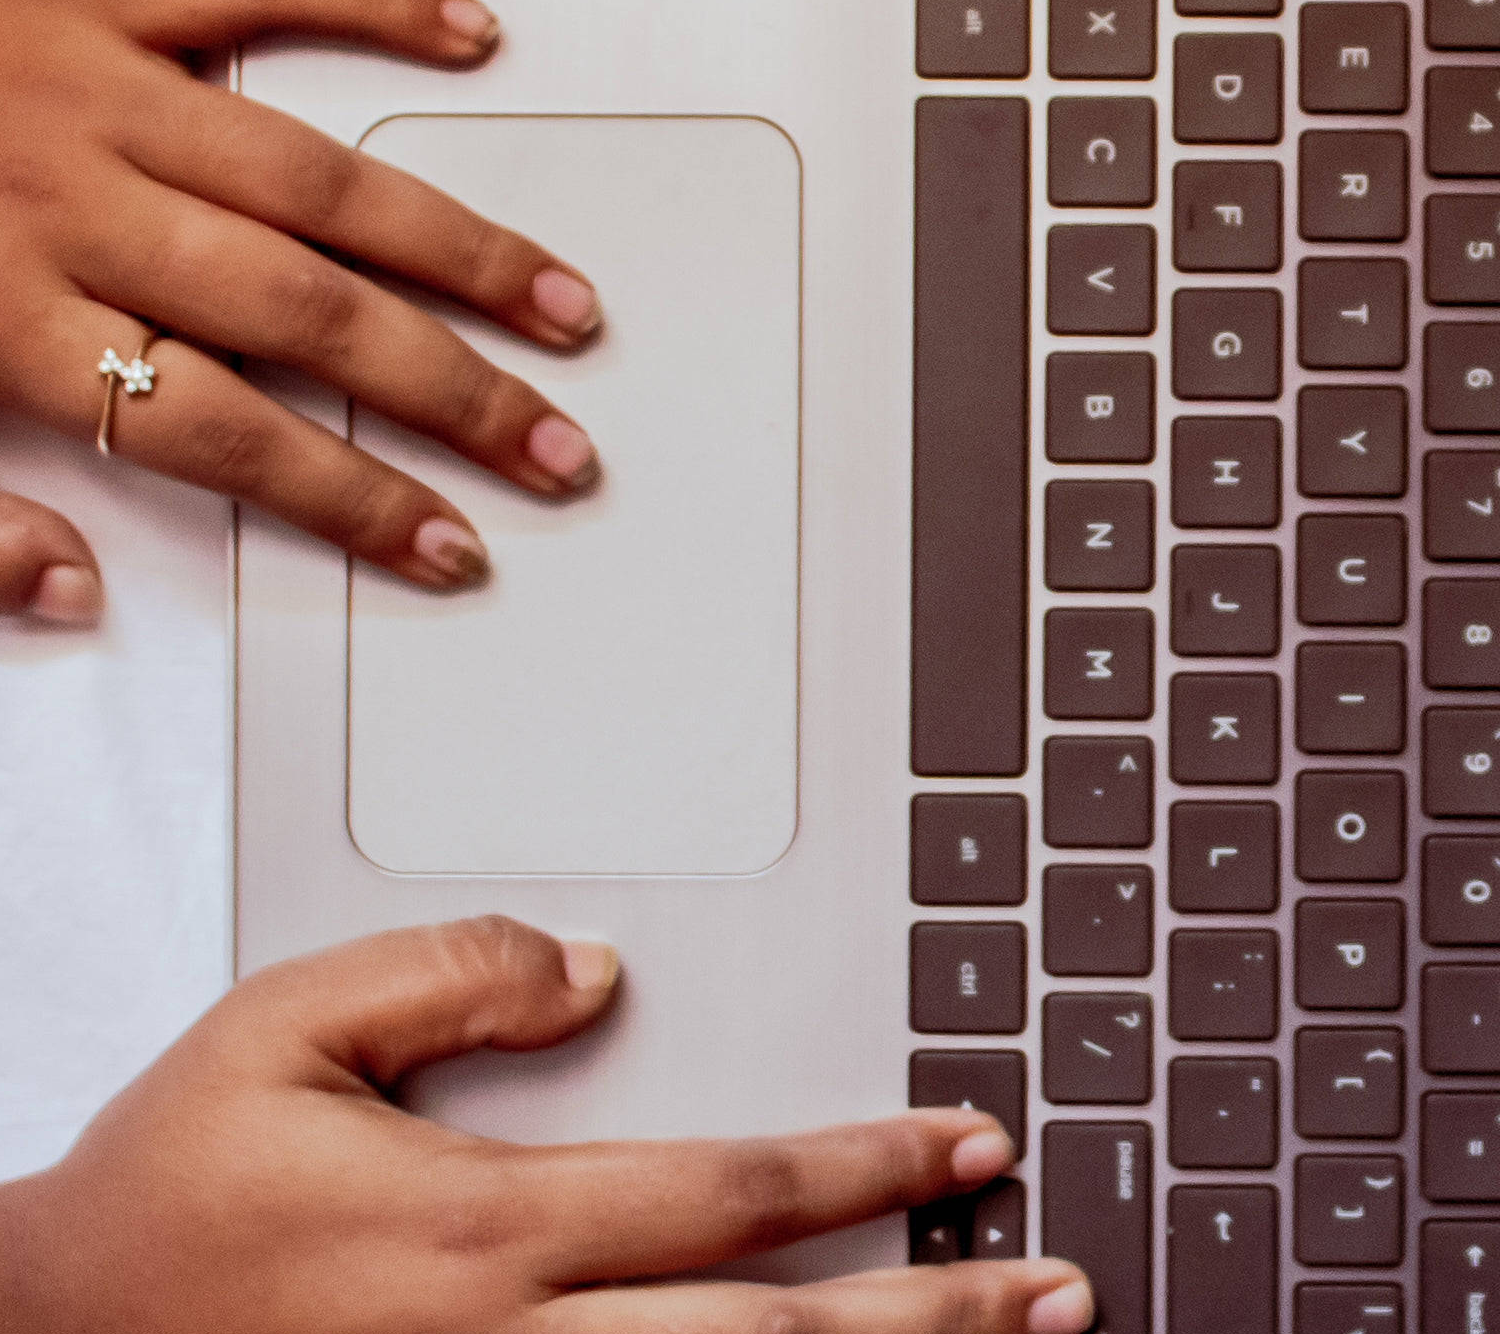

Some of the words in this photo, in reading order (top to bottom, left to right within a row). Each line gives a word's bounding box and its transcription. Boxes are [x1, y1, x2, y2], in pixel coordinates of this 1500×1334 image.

[964, 7, 983, 35] alt
[1086, 9, 1116, 35] X
[1338, 45, 1370, 69] E
[1211, 73, 1243, 101] D
[1467, 111, 1494, 134] 4
[1084, 136, 1117, 163] C
[1338, 172, 1370, 199] R
[1212, 203, 1244, 227] F
[1464, 239, 1495, 261] 5
[1084, 265, 1115, 293] V
[1338, 302, 1369, 325] T
[1210, 329, 1242, 359] G
[1464, 366, 1494, 389] 6
[1082, 393, 1114, 421] B
[1338, 429, 1368, 455] Y
[1212, 459, 1240, 486] H
[1465, 496, 1494, 517] 7
[1084, 521, 1114, 550] N
[1336, 557, 1366, 585] U
[1209, 591, 1240, 613] J
[1462, 623, 1493, 646] 8
[1084, 649, 1113, 679] M
[1210, 715, 1239, 741] K
[1117, 753, 1138, 772] <
[1462, 751, 1492, 775] 9
[1334, 811, 1367, 843] O
[958, 835, 979, 863] alt
[1207, 845, 1238, 868] L
[1116, 882, 1137, 901] >
[1461, 878, 1492, 905] 0
[1334, 942, 1366, 968] P
[1113, 1011, 1141, 1029] ?
[1114, 1139, 1134, 1201] pause
